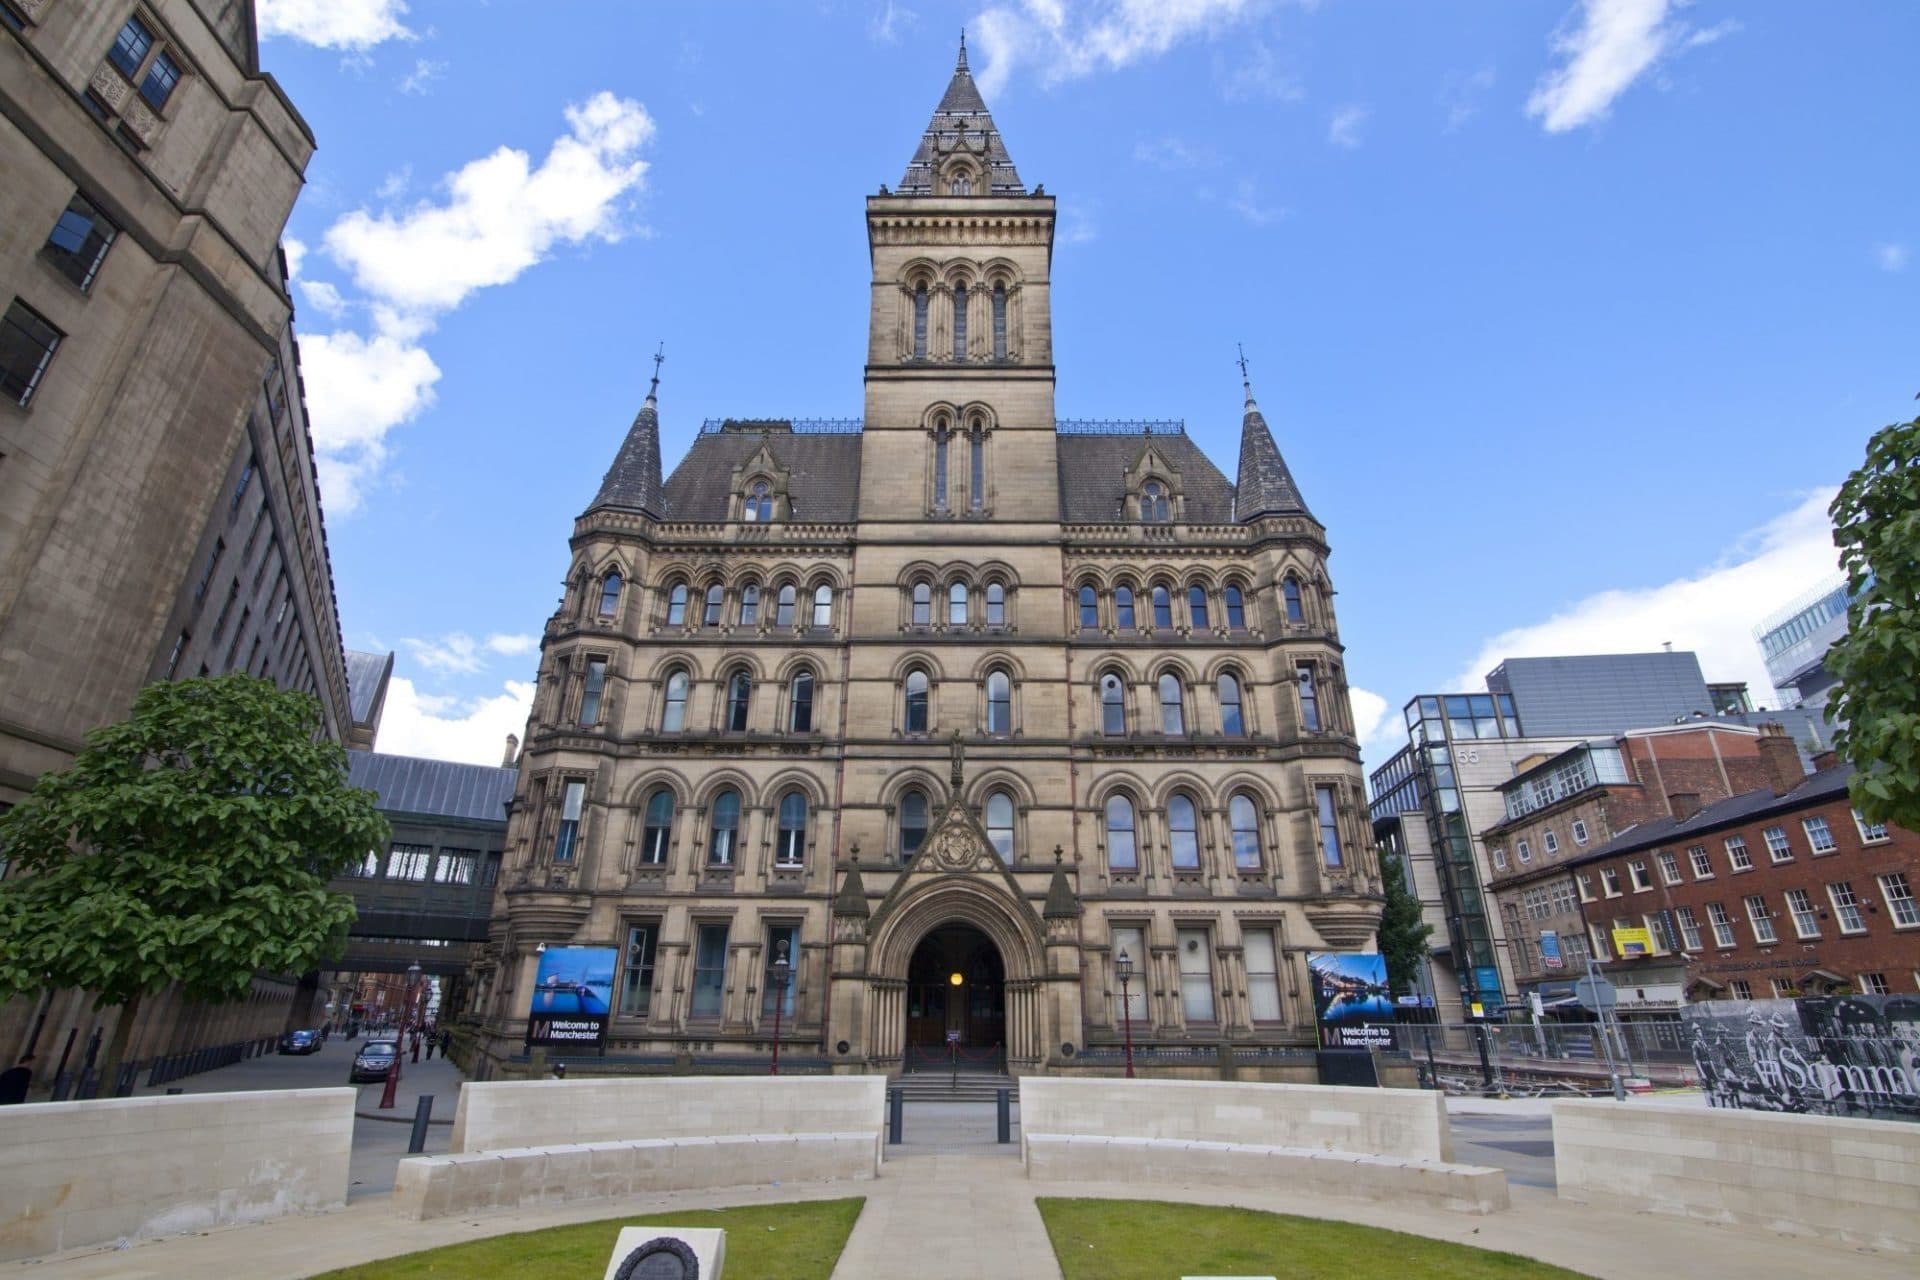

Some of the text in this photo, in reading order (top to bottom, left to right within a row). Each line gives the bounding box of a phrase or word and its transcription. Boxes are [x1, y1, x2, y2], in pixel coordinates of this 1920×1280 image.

[1458, 750, 1479, 763] 55
[552, 1020, 599, 1030] Welcome to
[551, 1031, 599, 1039] Manchester
[1341, 1027, 1390, 1036] Welcome to
[1343, 1037, 1391, 1046] Manchester
